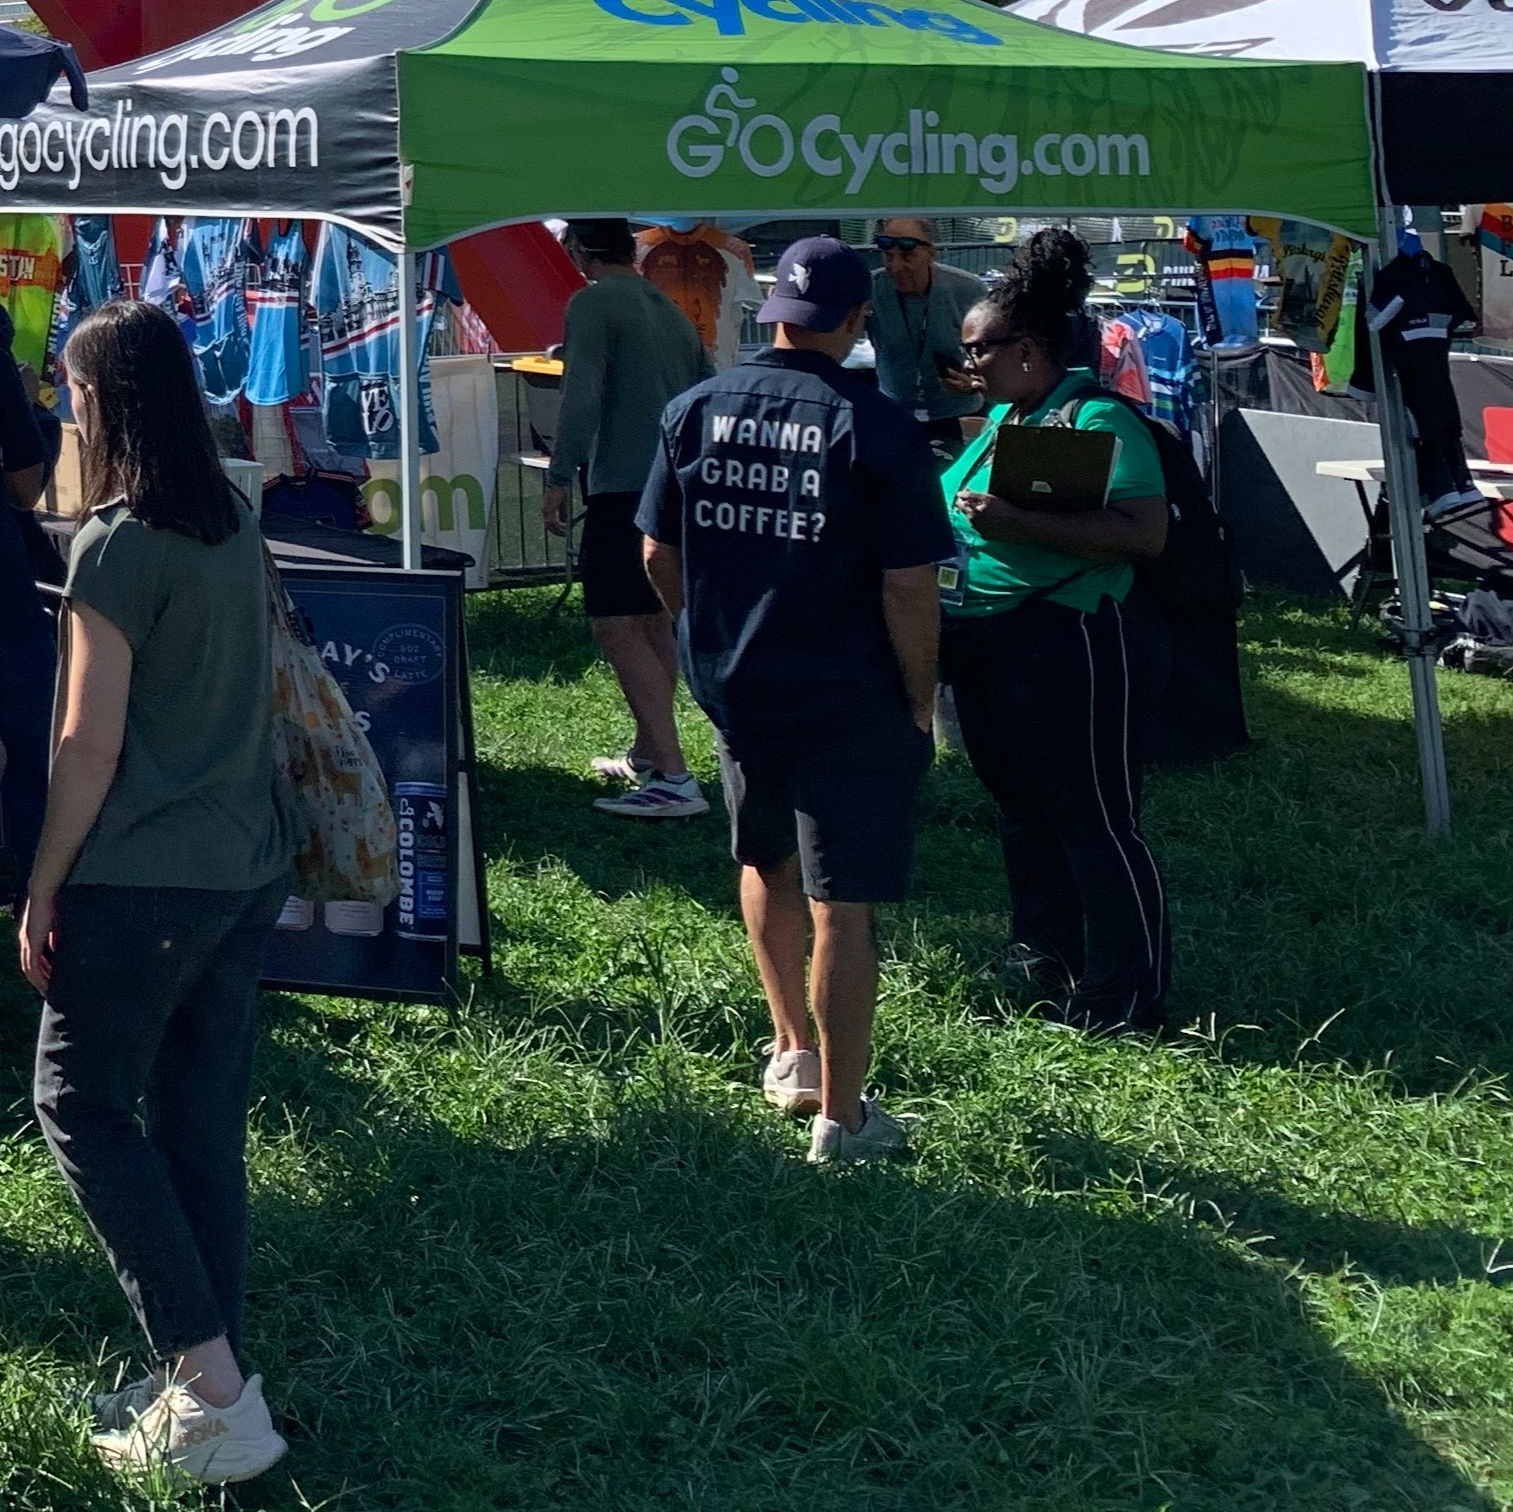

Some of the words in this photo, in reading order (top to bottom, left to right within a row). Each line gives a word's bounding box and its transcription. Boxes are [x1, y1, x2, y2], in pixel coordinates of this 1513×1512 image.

[713, 415, 822, 453] WANNA
[701, 457, 790, 493] GRAB
[800, 469, 820, 498] A
[695, 500, 827, 543] COFFEE?
[321, 640, 391, 684] AY'S
[398, 817, 415, 930] COLOMBE
